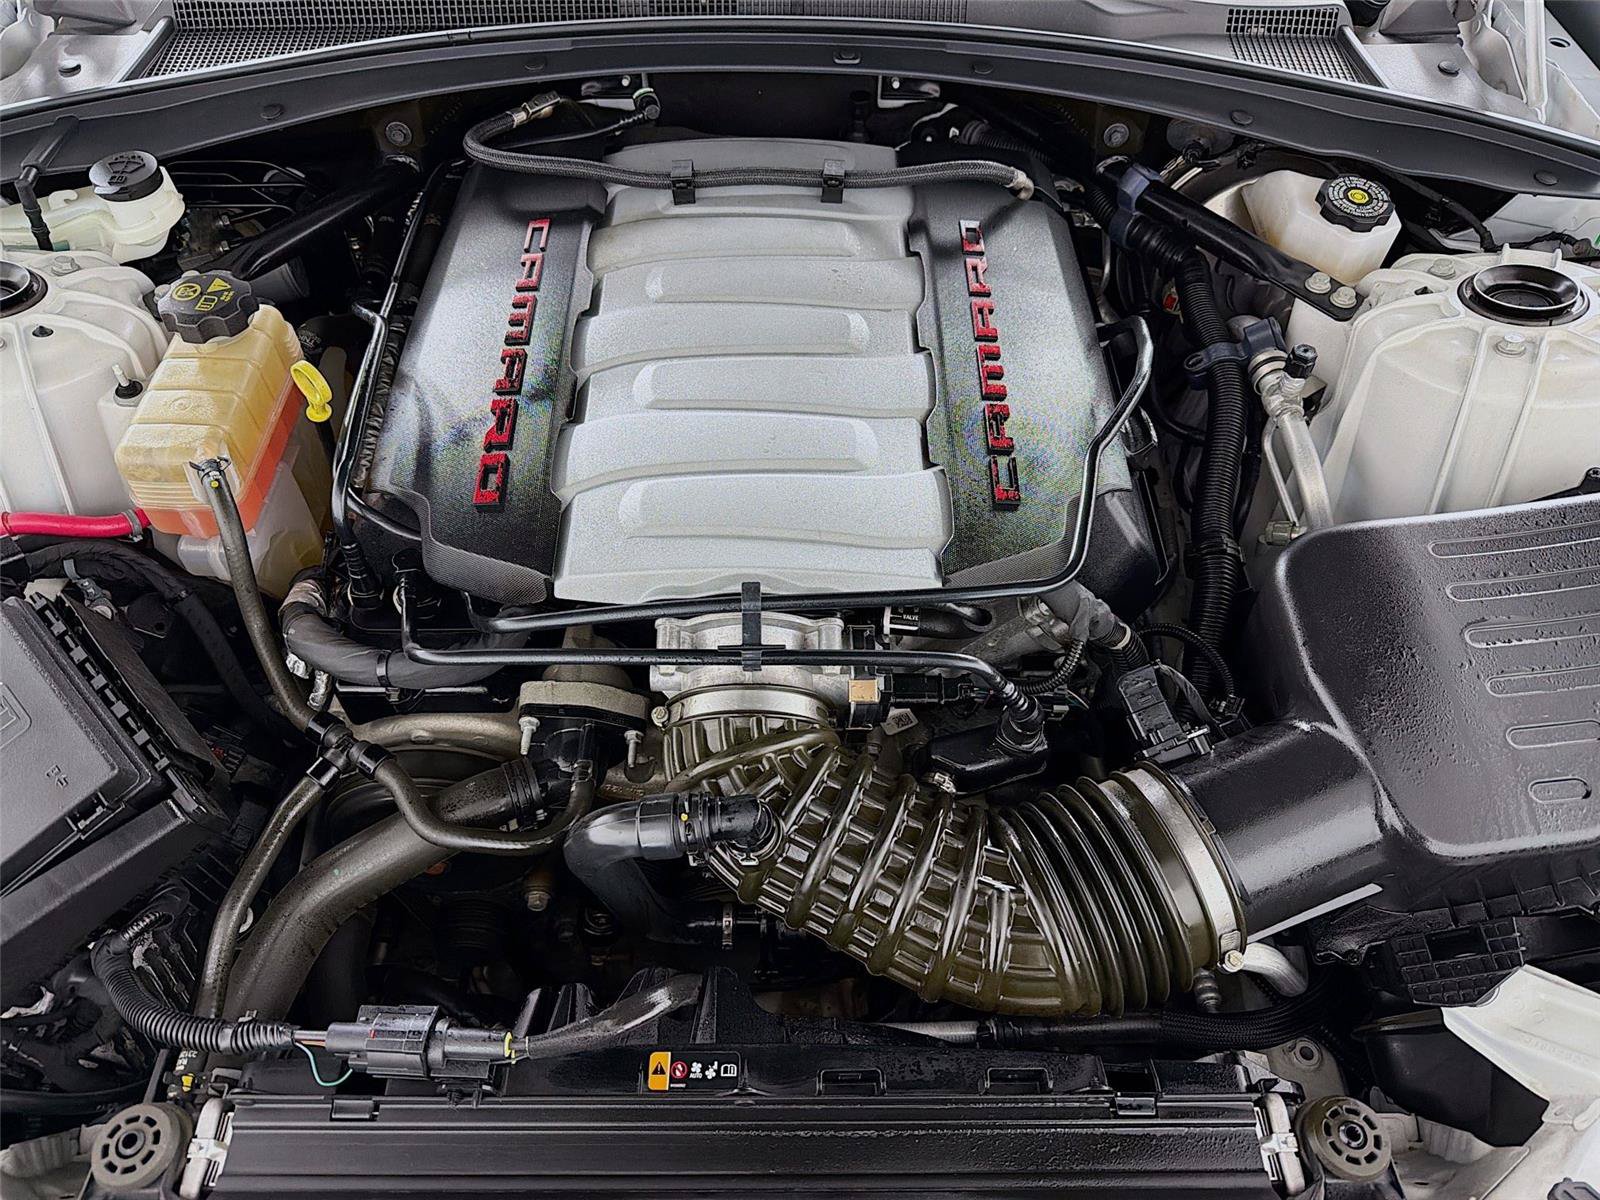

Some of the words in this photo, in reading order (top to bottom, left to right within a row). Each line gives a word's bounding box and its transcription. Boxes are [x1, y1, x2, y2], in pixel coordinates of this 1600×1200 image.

[473, 218, 550, 509] CAMARO
[959, 219, 1021, 508] CAMARO
[902, 613, 919, 621] VALVE
